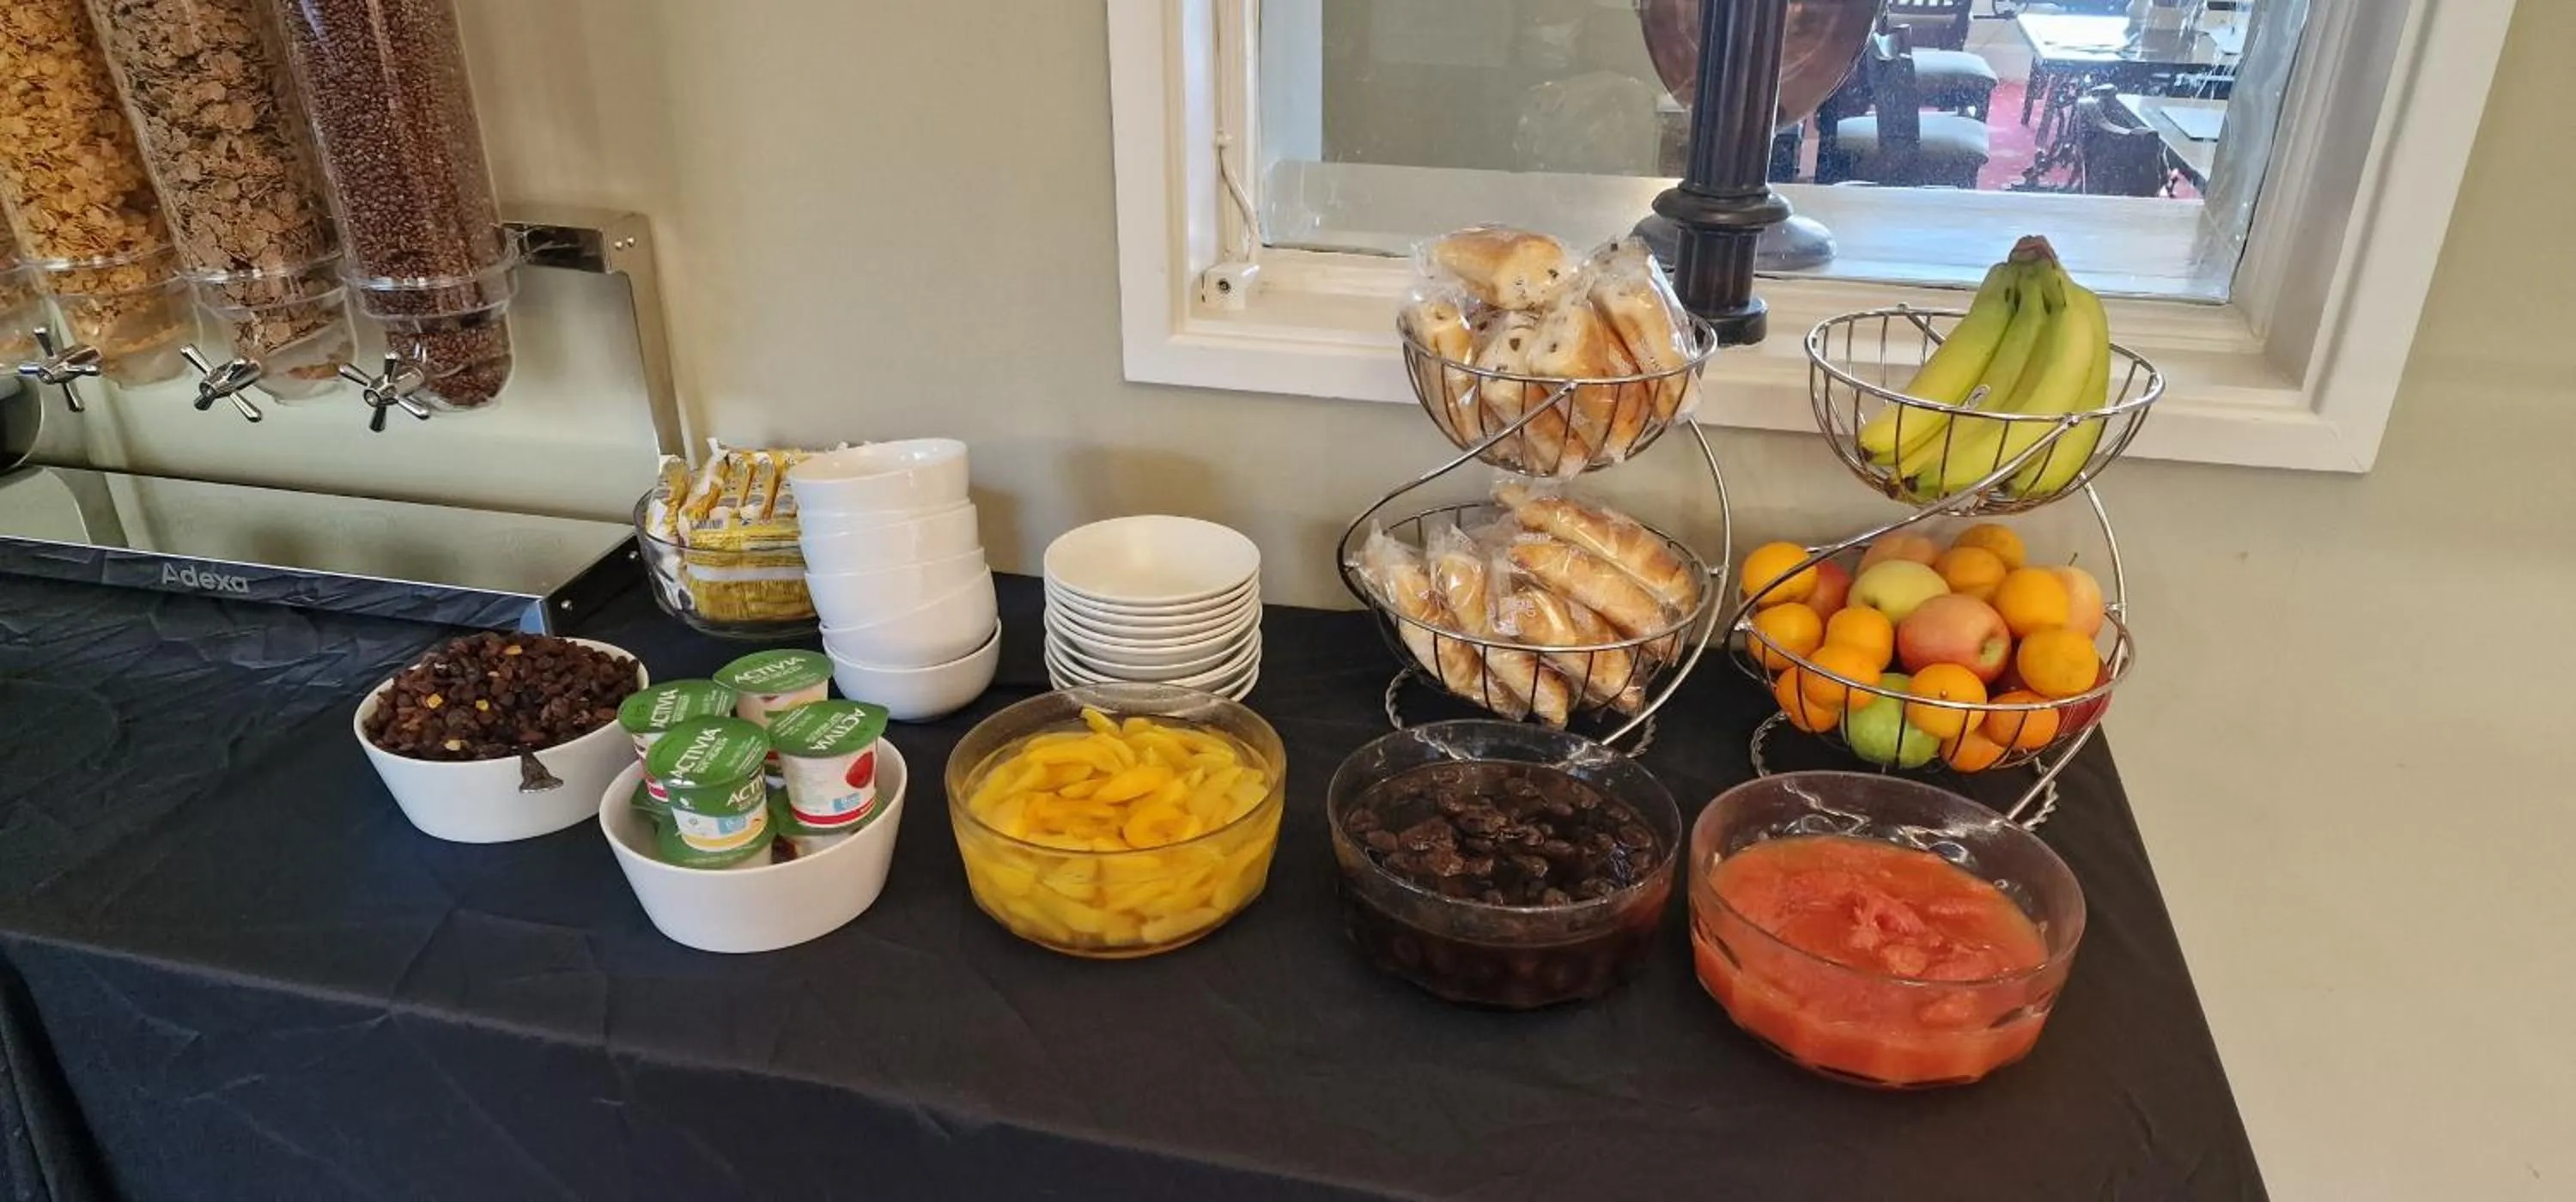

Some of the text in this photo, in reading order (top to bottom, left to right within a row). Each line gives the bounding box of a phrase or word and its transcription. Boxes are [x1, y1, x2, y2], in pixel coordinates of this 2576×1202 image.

[161, 562, 249, 592] Adexa
[735, 655, 806, 684] ACTIVIA
[650, 688, 678, 729] ACTIVIA
[810, 707, 866, 750] ACTIVIA
[670, 726, 722, 780] ACTIVIA
